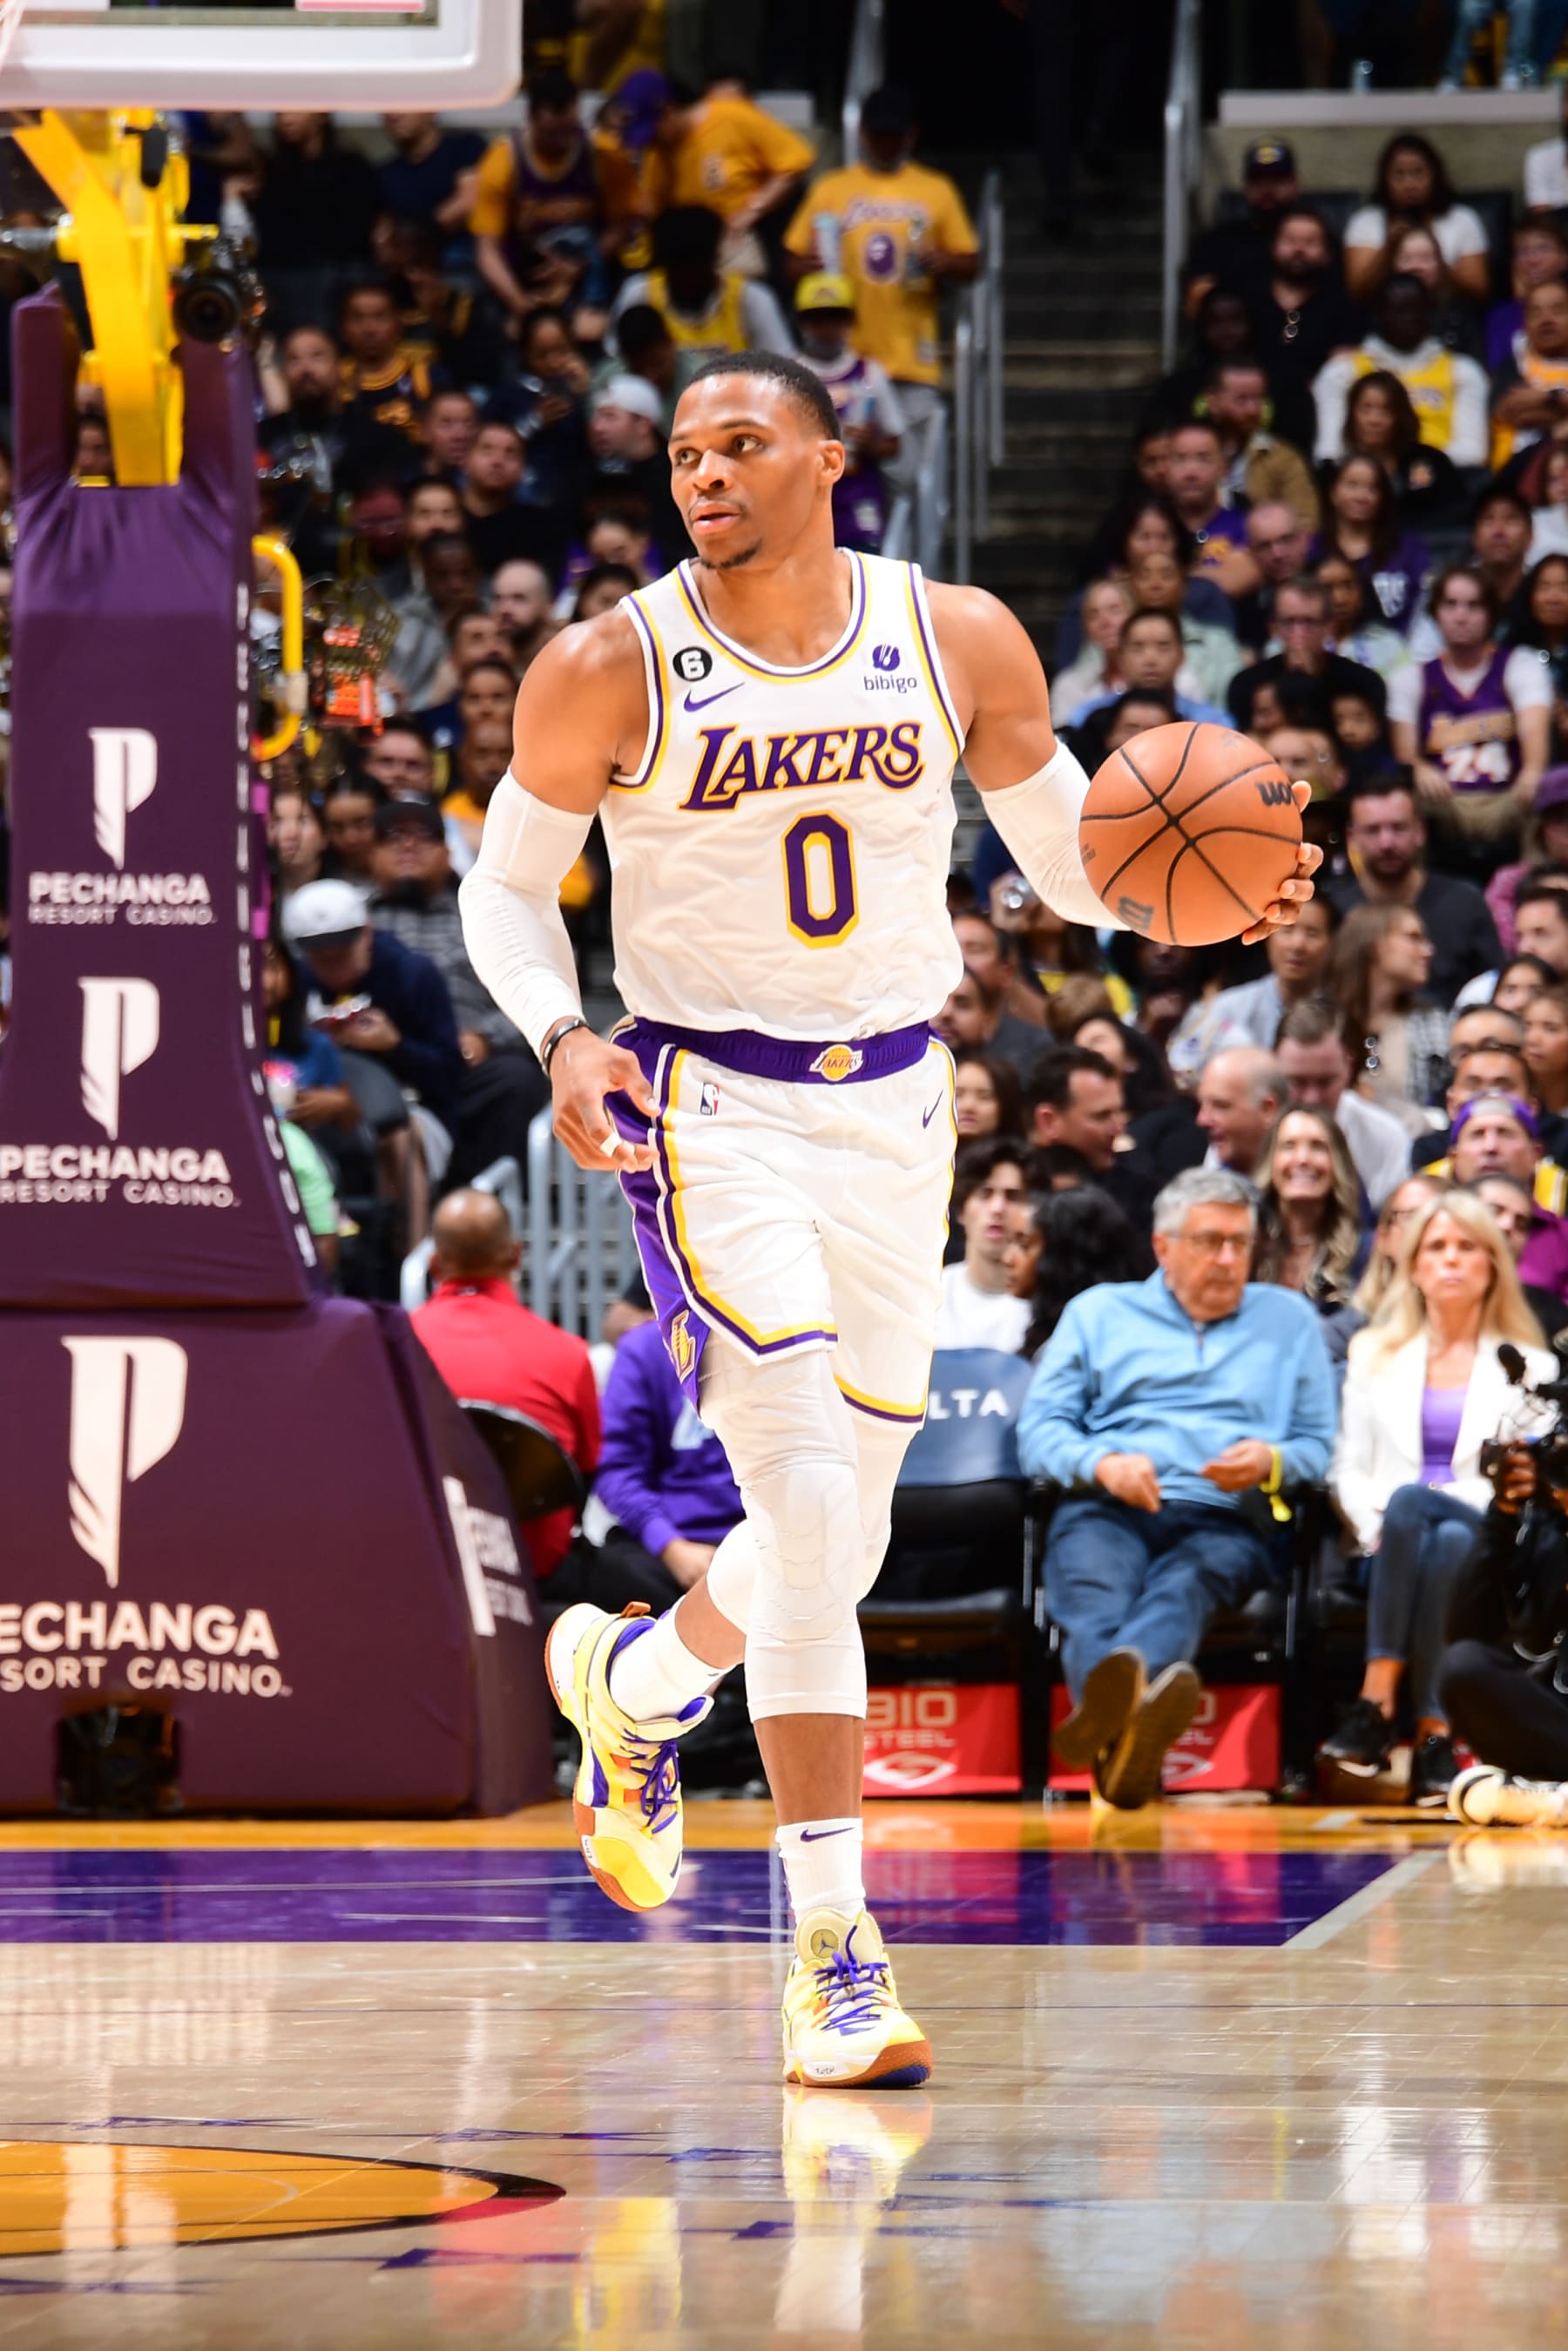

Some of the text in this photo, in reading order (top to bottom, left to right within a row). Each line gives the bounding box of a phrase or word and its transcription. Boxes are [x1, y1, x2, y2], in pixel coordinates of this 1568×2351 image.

[680, 650, 704, 679] 6
[863, 674, 917, 694] bibigo
[677, 721, 925, 812] LAKERS
[28, 871, 212, 905] PECHANGA
[781, 809, 860, 949] 0
[28, 904, 118, 924] RESORT
[0, 1144, 232, 1184] PECHANGA
[0, 1179, 112, 1204] RESORT
[928, 1388, 1010, 1420] LTA
[0, 1601, 280, 1659] ECHANGA
[0, 1656, 108, 1692] SORT
